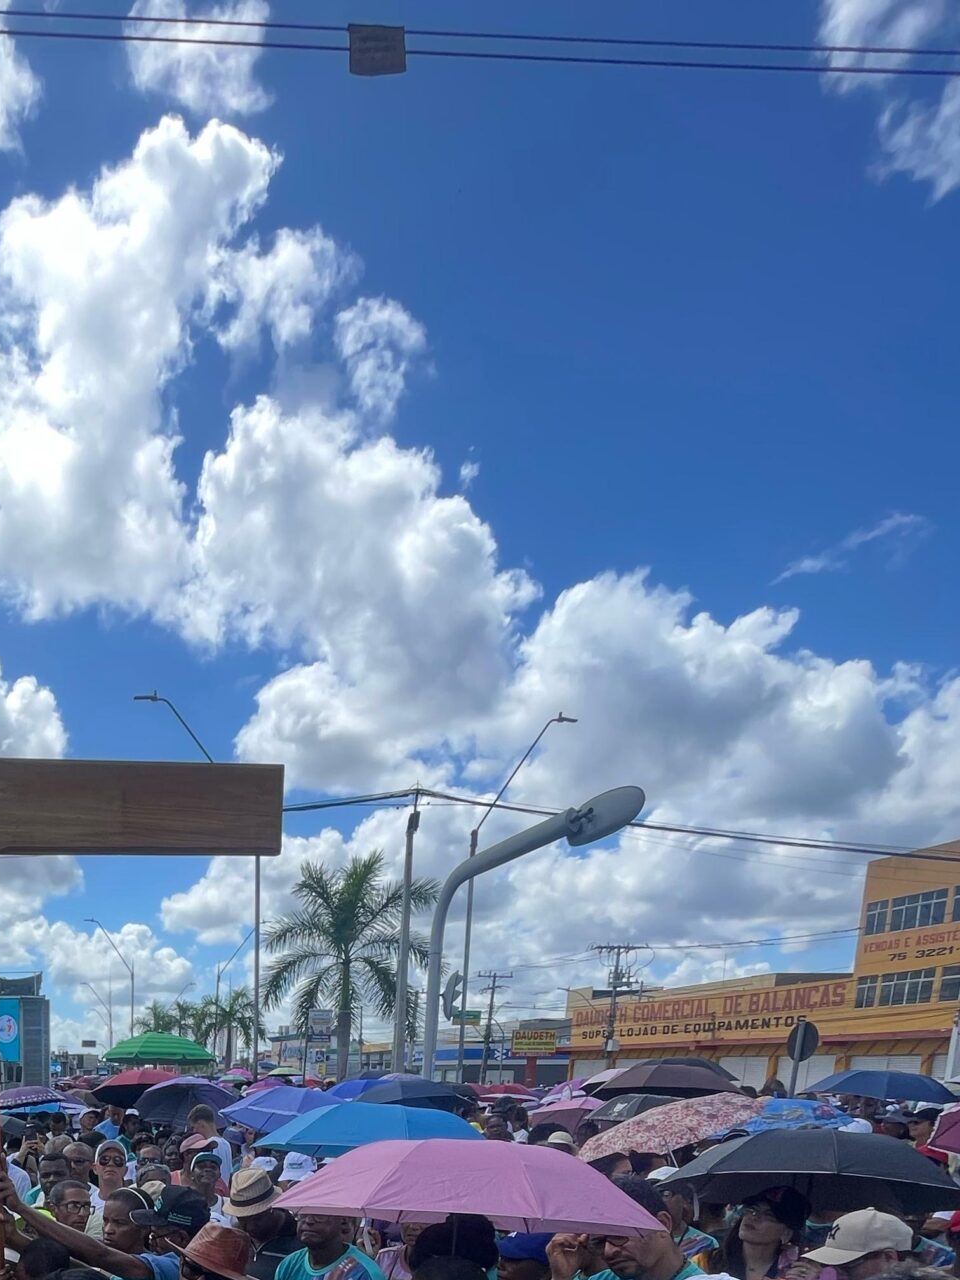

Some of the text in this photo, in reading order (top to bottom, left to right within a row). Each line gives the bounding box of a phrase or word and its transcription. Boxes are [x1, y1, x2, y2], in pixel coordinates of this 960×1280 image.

[863, 939, 900, 953] VENDAS
[904, 937, 912, 948] E
[888, 952, 907, 961] 75
[633, 999, 712, 1023] COMERCIAL
[722, 995, 742, 1015] DE
[748, 983, 846, 1014] BALANÇAS
[582, 1014, 807, 1039] SUPE LOJÃO DE EQUIPAMENTOS
[515, 1031, 555, 1040] DAUDETH
